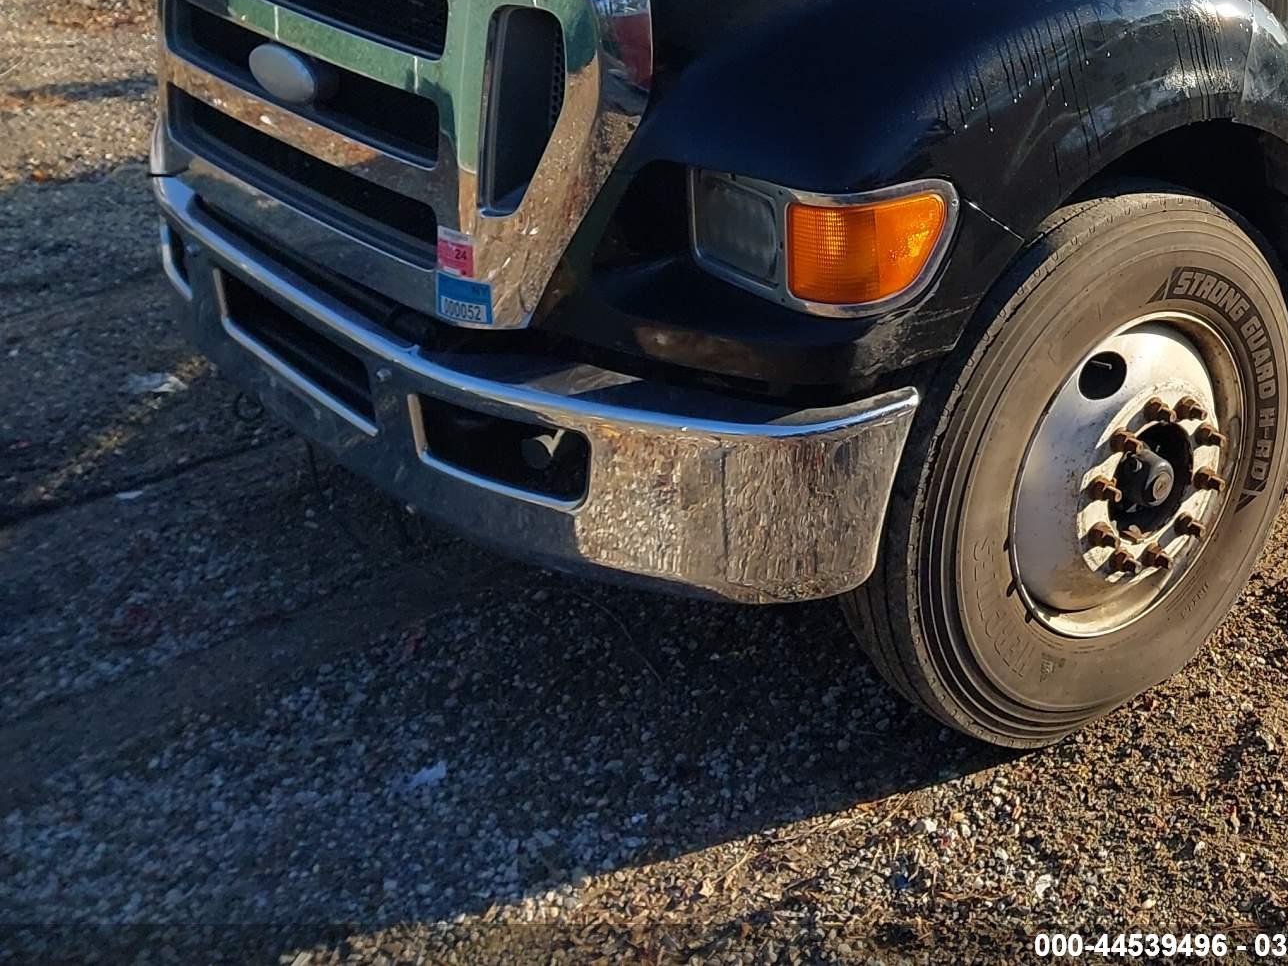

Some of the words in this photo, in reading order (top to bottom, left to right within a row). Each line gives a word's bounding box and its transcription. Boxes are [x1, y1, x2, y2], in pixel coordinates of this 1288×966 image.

[455, 248, 467, 260] 24
[444, 298, 481, 320] 000052
[1173, 270, 1251, 323] STRONG
[1241, 314, 1277, 401] GUARD
